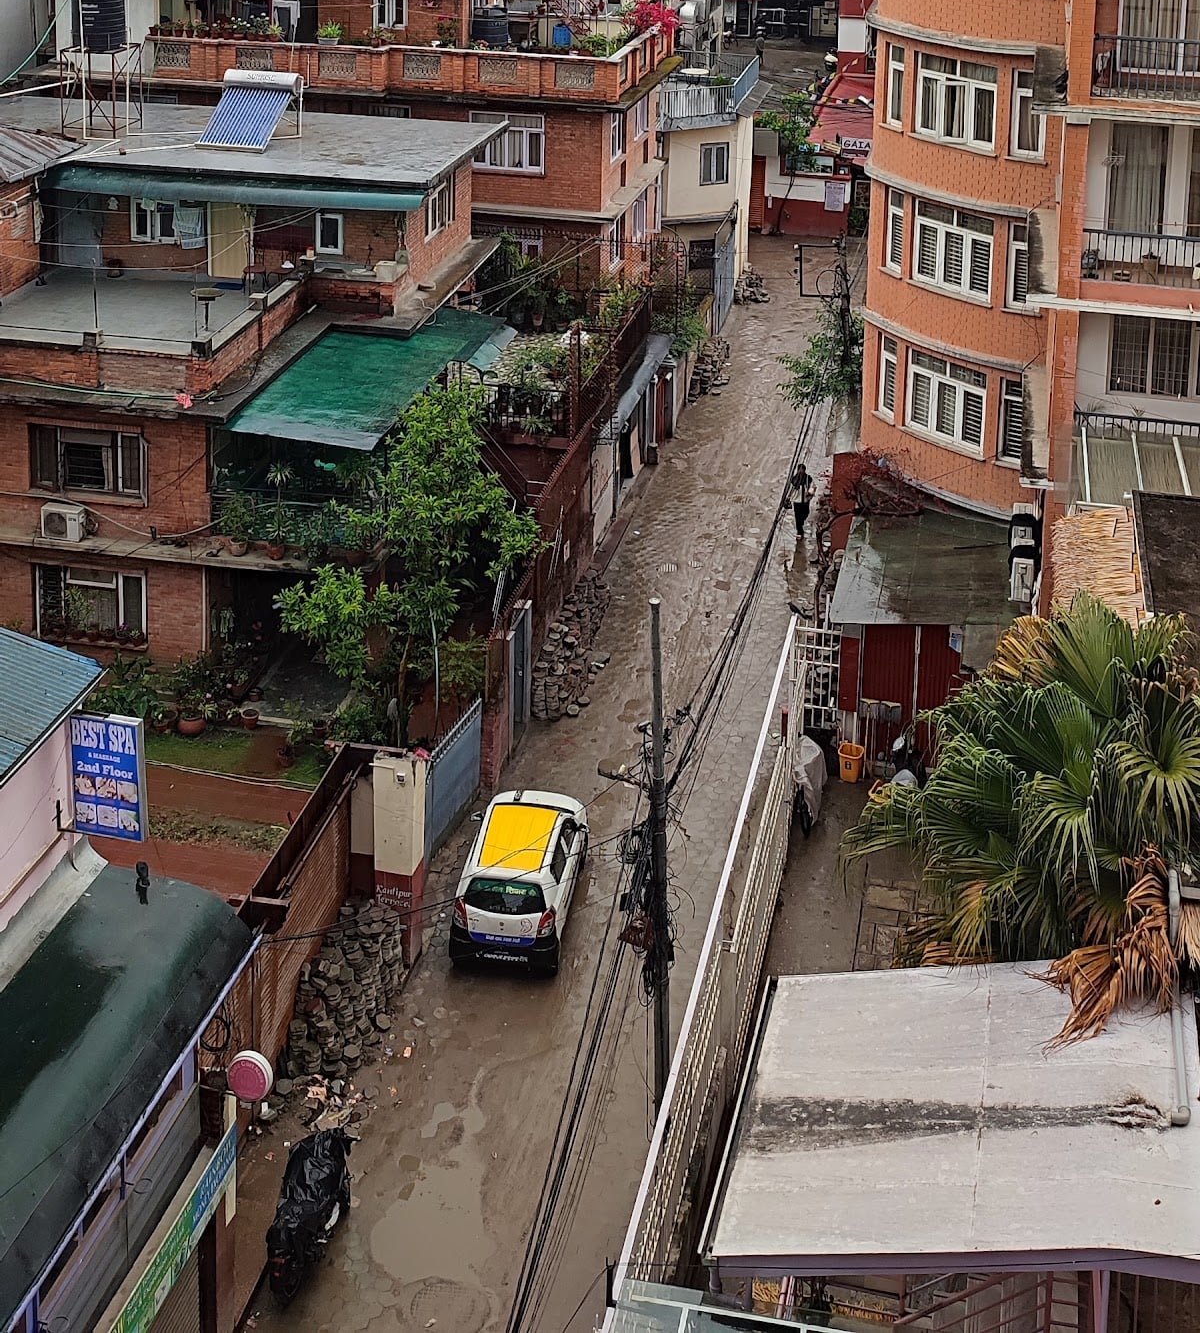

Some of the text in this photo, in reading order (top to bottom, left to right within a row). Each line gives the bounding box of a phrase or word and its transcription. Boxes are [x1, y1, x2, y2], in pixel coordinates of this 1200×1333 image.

[843, 139, 871, 150] GAIA
[71, 718, 136, 756] BEST SPA
[77, 761, 134, 780] 2nd Floor
[376, 884, 412, 899] Kantipur
